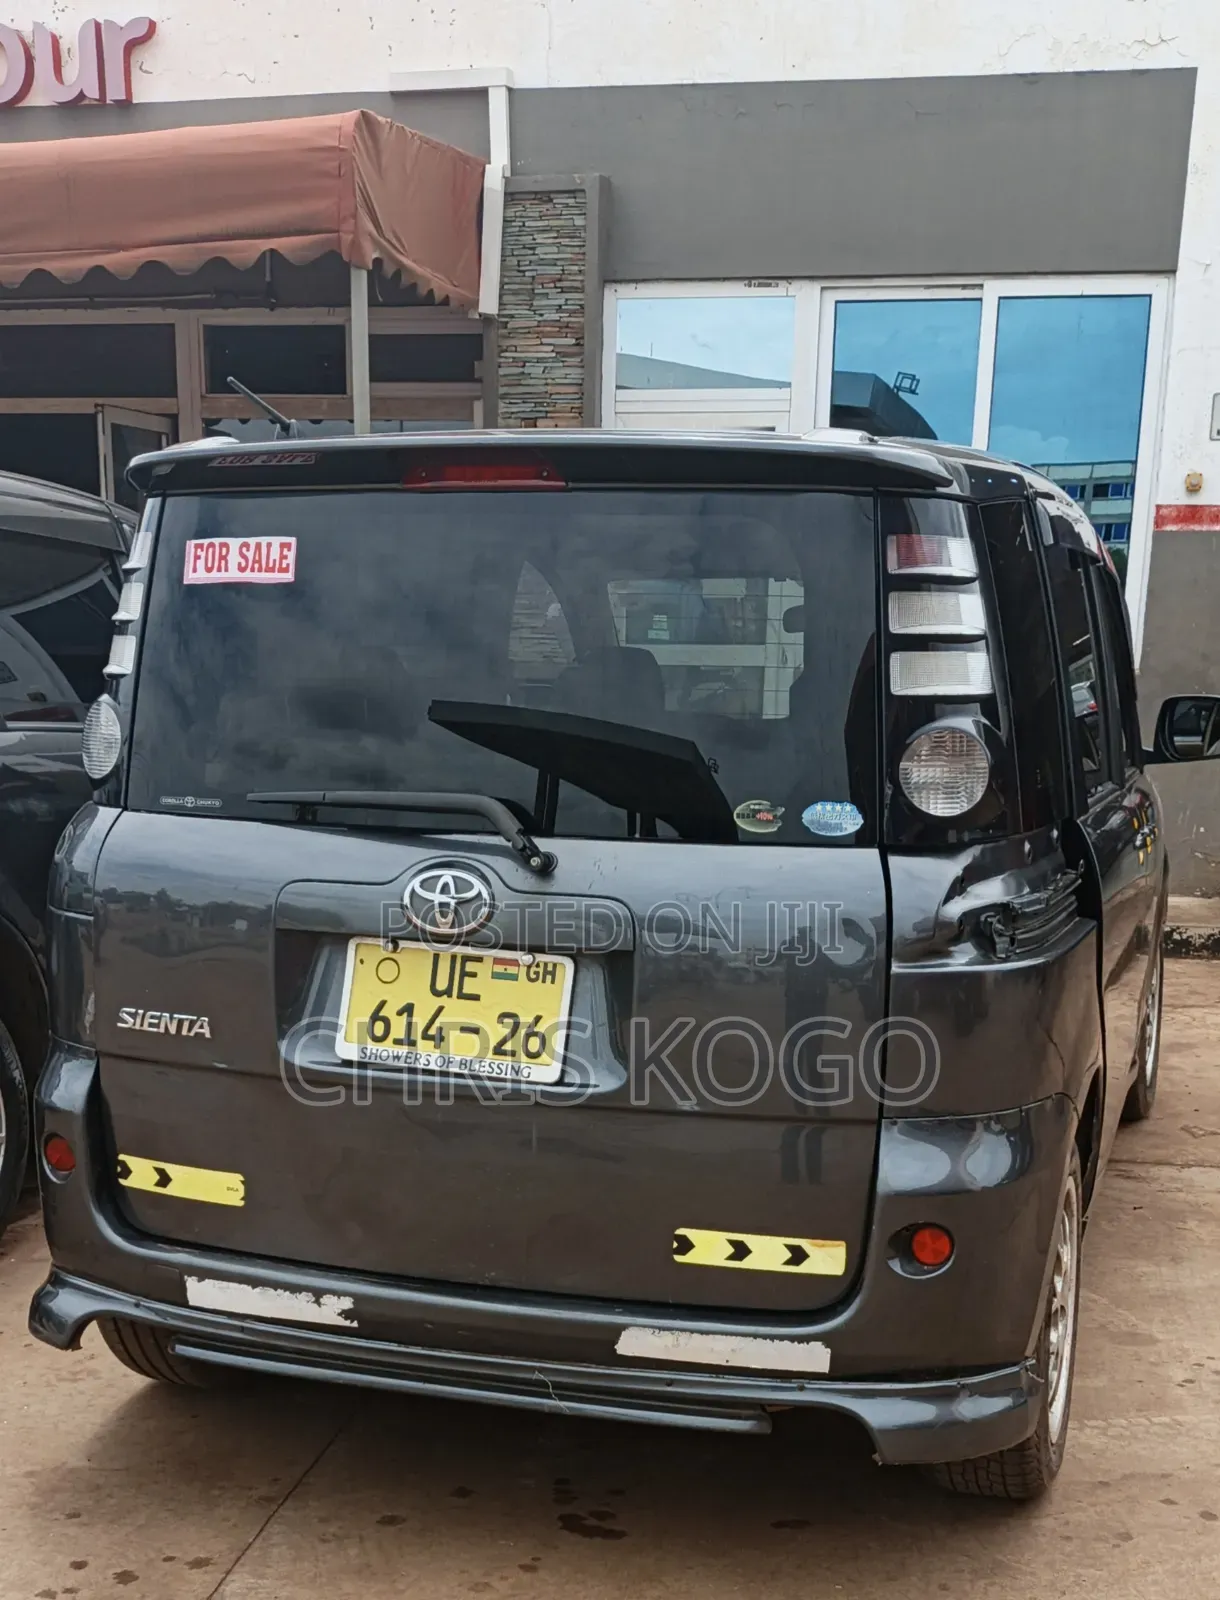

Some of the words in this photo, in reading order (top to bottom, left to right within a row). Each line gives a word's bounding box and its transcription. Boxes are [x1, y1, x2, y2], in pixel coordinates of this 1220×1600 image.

[192, 541, 230, 574] FOR
[237, 541, 292, 574] SALE
[429, 953, 484, 1001] UE
[525, 963, 558, 985] GH
[116, 1007, 212, 1039] SIENTA
[359, 1046, 432, 1068] SHOWERS
[435, 1055, 454, 1069] OF
[458, 1059, 532, 1080] BLESSING
